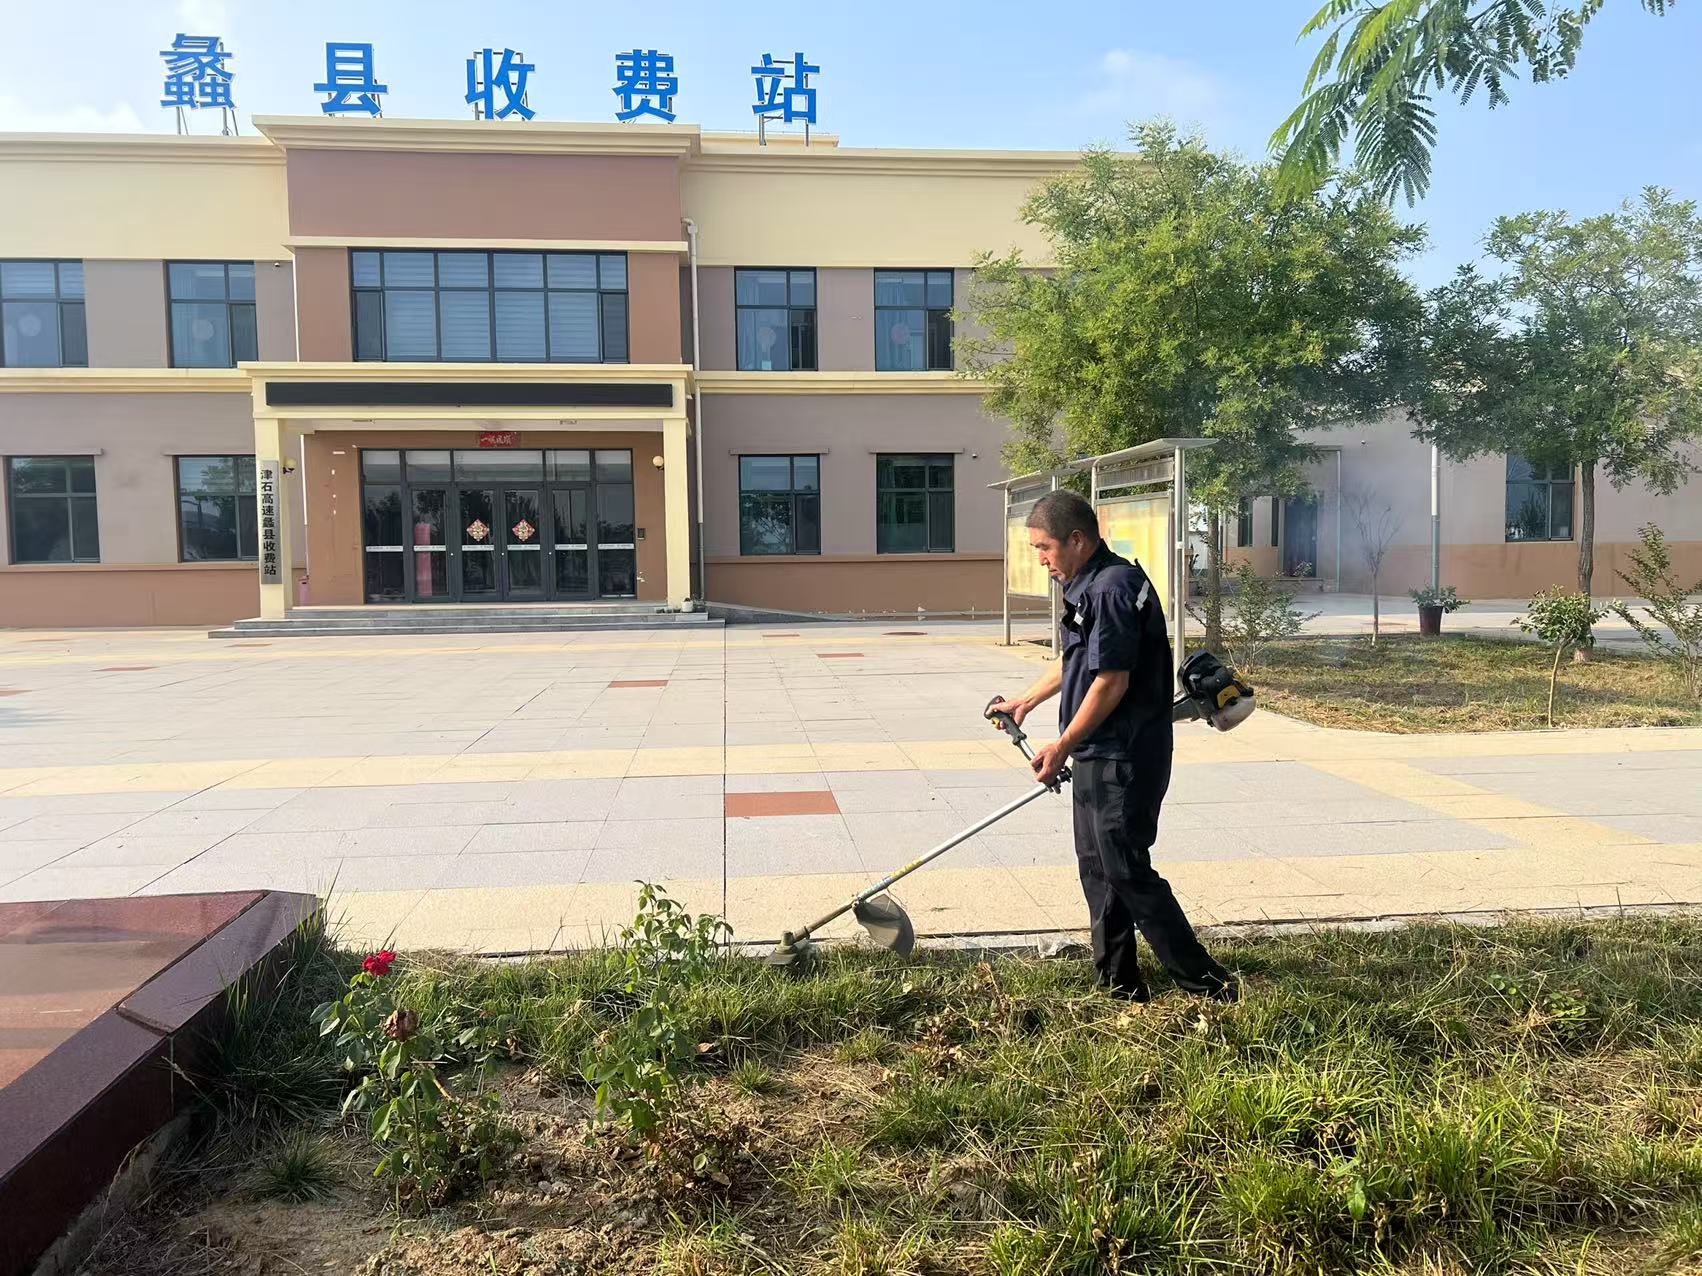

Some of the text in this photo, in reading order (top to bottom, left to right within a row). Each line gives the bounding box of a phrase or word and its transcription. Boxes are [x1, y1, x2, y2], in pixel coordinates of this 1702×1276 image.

[160, 32, 821, 124] 蠡县收费站
[260, 469, 277, 576] 津石高速蠡县收费站
